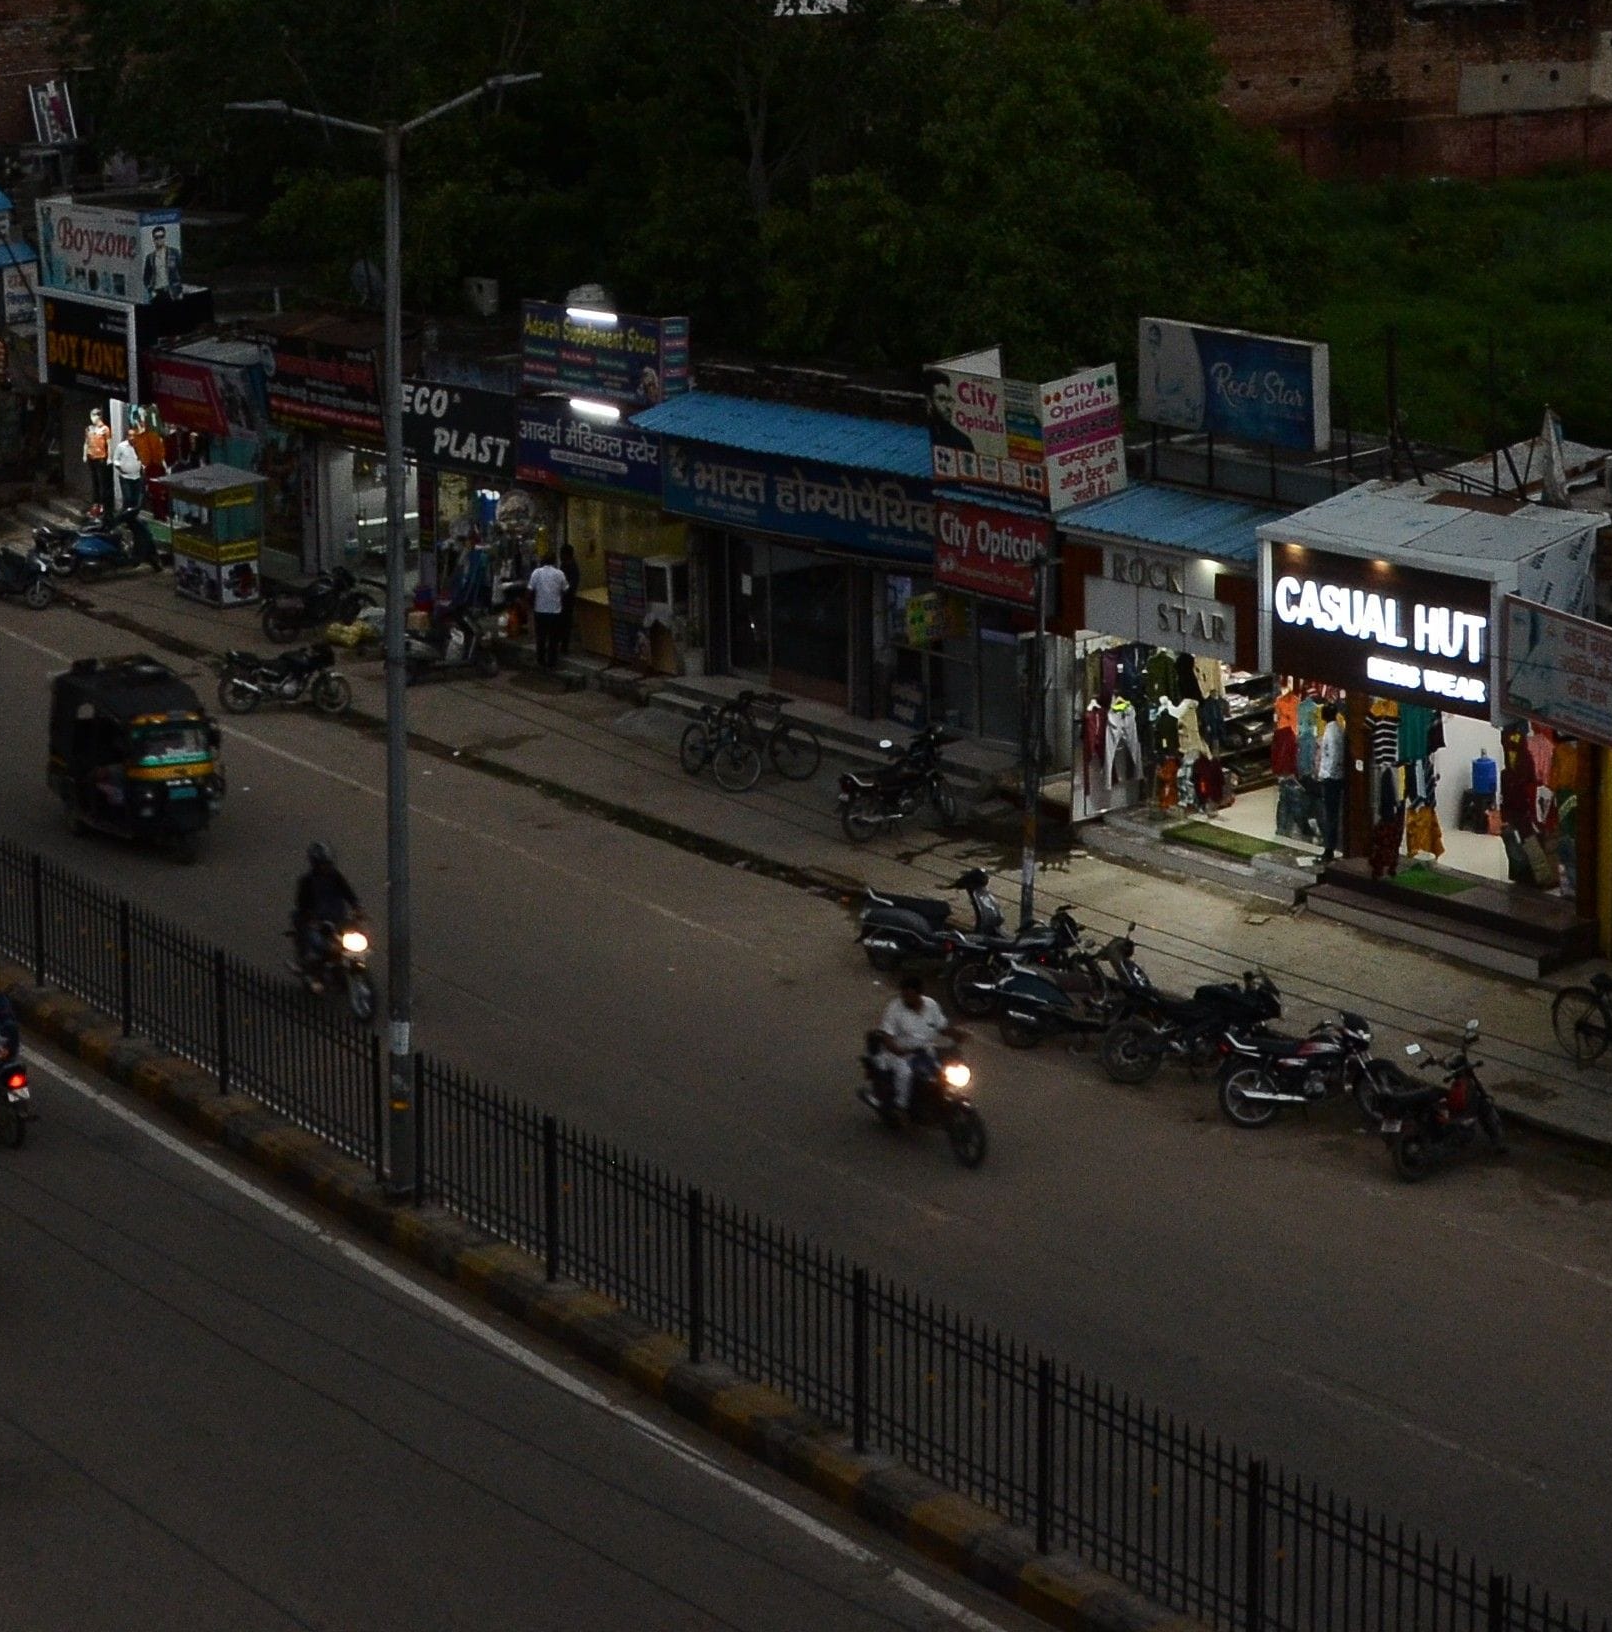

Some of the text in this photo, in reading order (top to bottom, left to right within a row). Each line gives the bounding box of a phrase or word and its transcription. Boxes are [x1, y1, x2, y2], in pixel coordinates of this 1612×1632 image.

[57, 217, 138, 265] Boyzone
[47, 330, 127, 381] BOY ZONE
[957, 382, 997, 415] City
[1050, 391, 1111, 419] Opticals
[1063, 381, 1095, 399] City
[1210, 362, 1306, 408] Rock Star
[519, 419, 562, 446] आदर्श
[626, 435, 659, 465] स्टोर
[956, 410, 1004, 434] Opticals
[433, 426, 511, 468] PLAST
[693, 461, 767, 504] भारत
[939, 510, 971, 557] City
[1112, 552, 1185, 594] ROCK
[1274, 575, 1409, 649] CASUAL
[1413, 603, 1488, 665] HUT
[1423, 668, 1487, 704] WEAR
